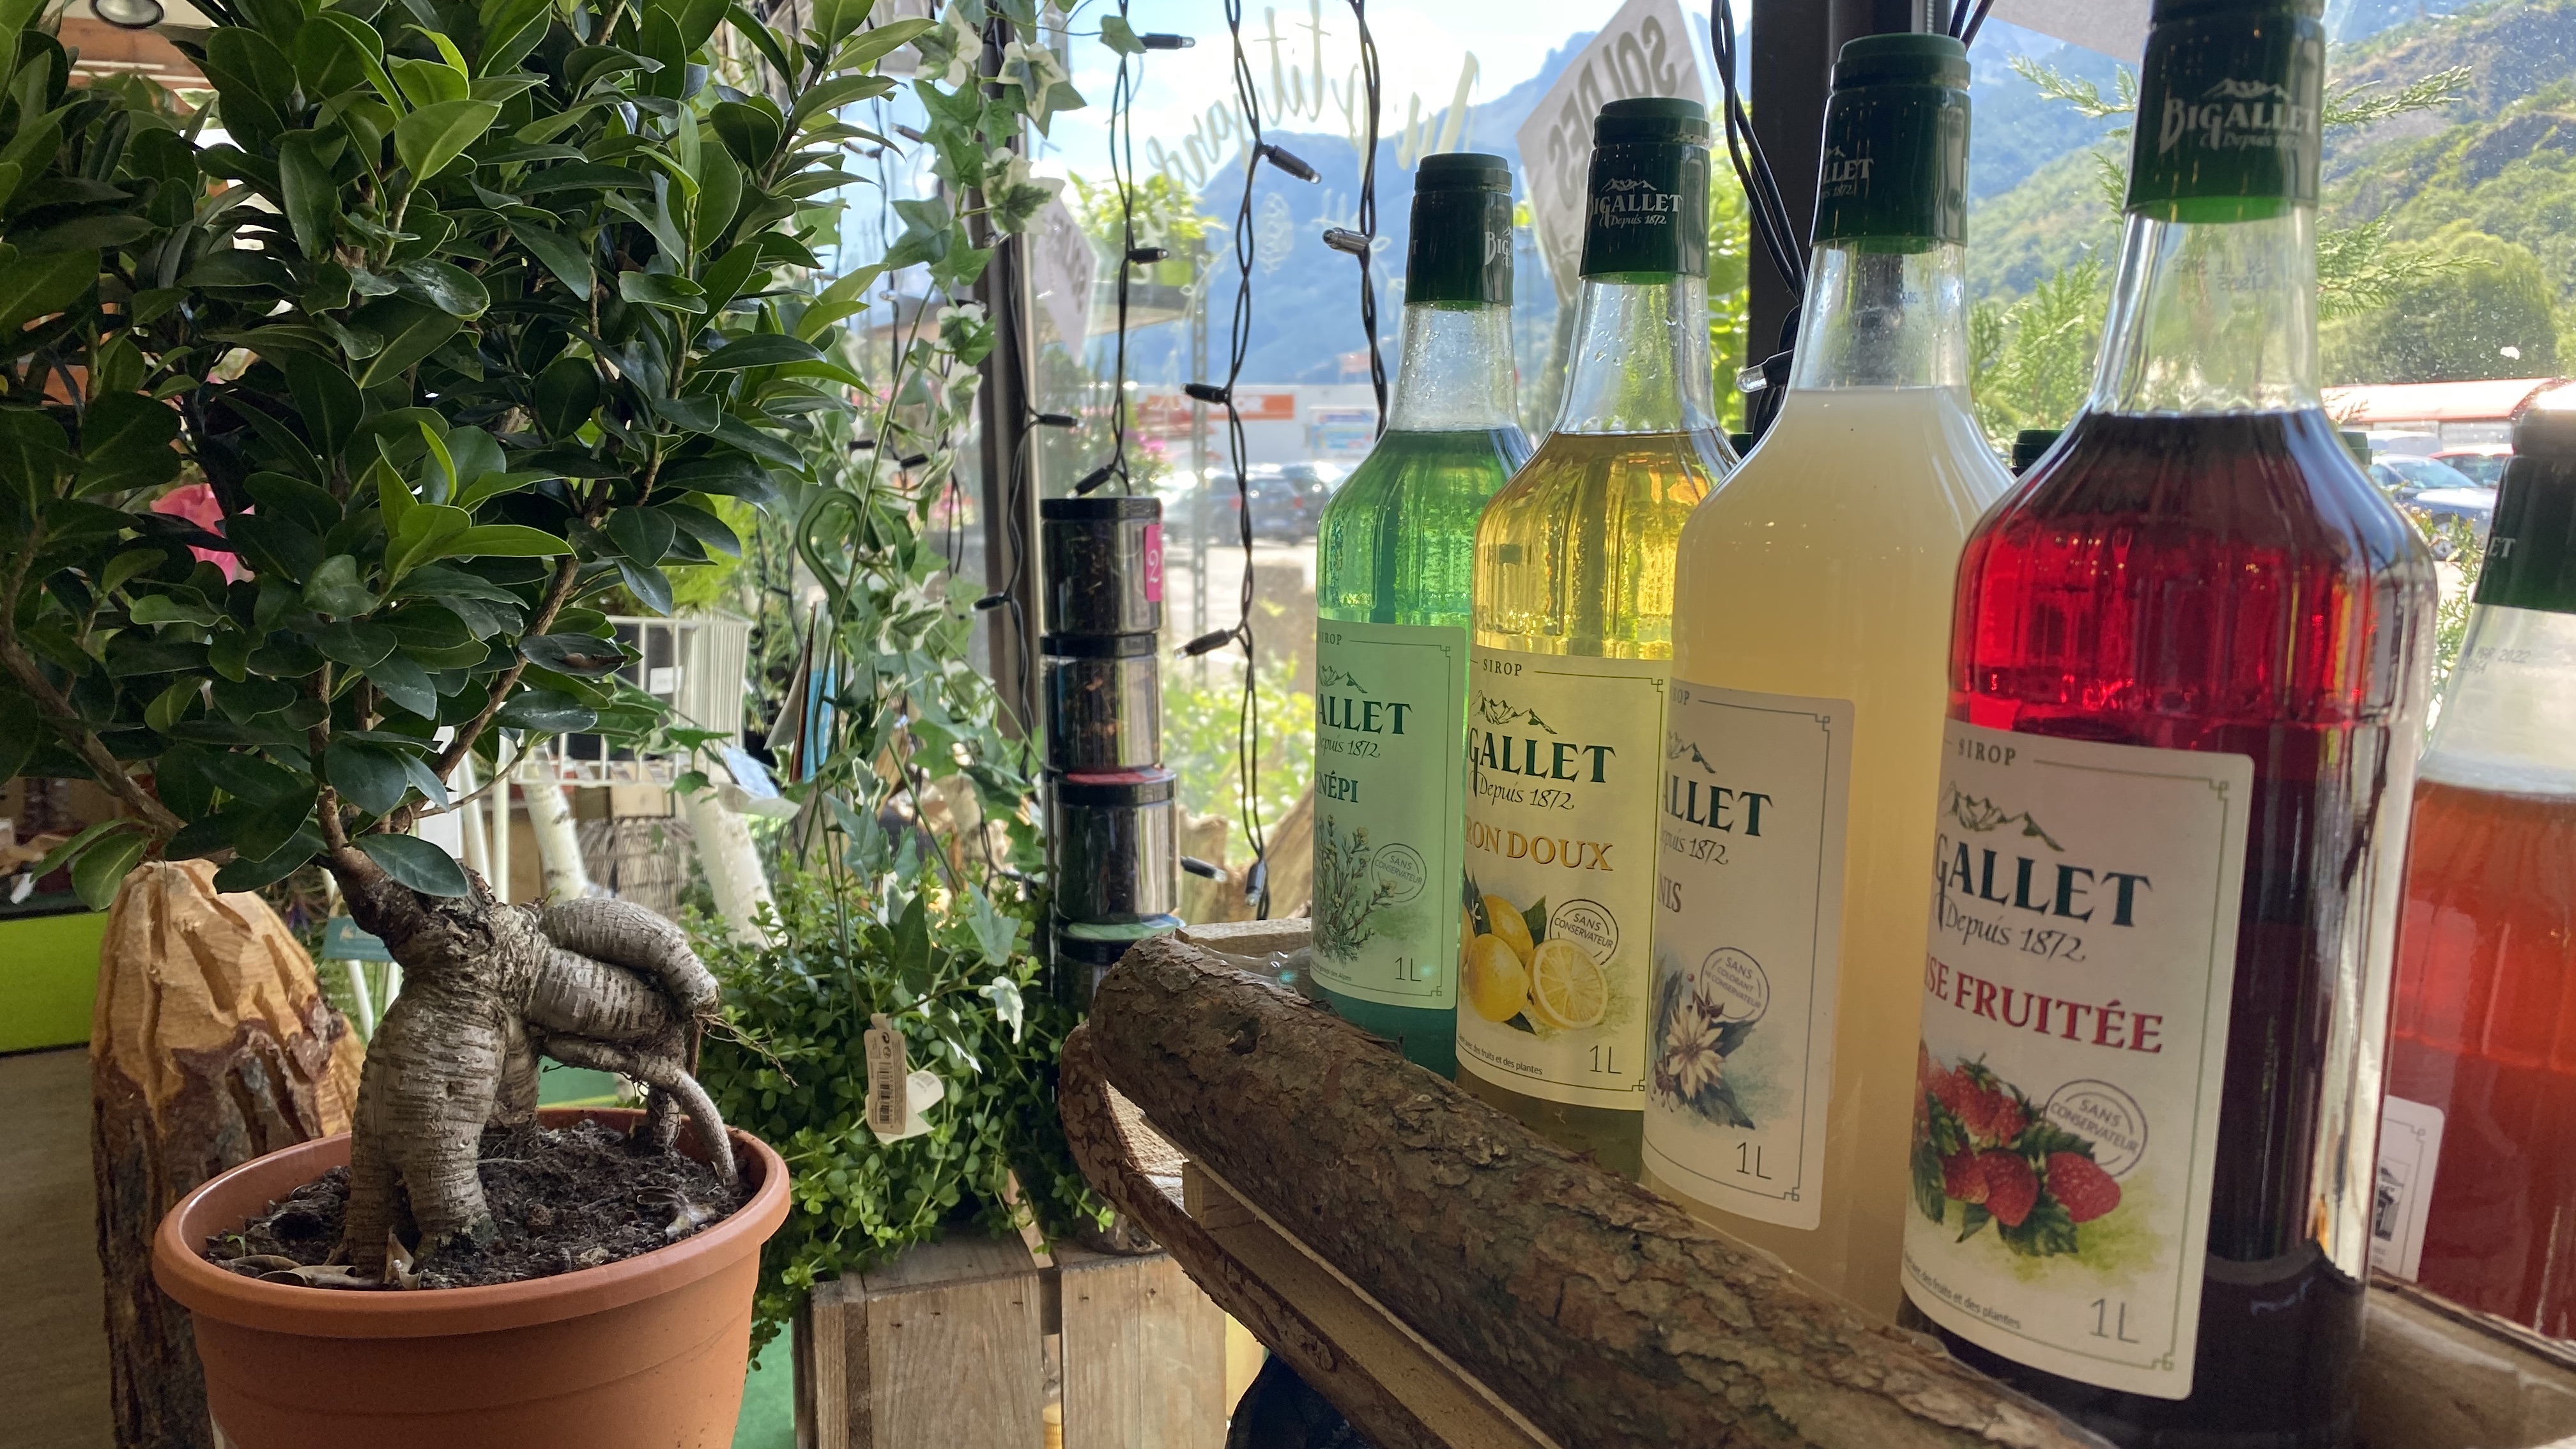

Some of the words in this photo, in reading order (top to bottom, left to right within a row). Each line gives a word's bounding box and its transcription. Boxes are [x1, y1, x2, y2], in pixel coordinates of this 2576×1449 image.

[2158, 98, 2317, 155] BIGALLET
[1824, 158, 1874, 183] LLET
[1611, 214, 1641, 229] Depuis
[1644, 214, 1667, 226] 1872
[1483, 659, 1522, 677] SIROP
[2497, 648, 2531, 664] 2022
[1317, 693, 1413, 735] ALLET
[1347, 739, 1381, 759] 1872
[1467, 726, 1616, 799] GALLET
[1958, 737, 2016, 766] SIROP
[1315, 769, 1359, 803] NÉPI
[1479, 776, 1524, 806] Depuis
[1529, 788, 1575, 811] 1872
[1465, 816, 1501, 855] RON
[1506, 830, 1614, 871] DOUX
[1662, 828, 1685, 854] puis
[1689, 837, 1729, 866] 1872
[1374, 859, 1423, 885] CONSERVATEUR
[1390, 855, 1413, 870] SANS
[1657, 870, 1682, 914] NIS
[1934, 833, 2153, 932] GALLET
[1554, 917, 1614, 949] CONSERVATEUR
[1573, 912, 1602, 931] SANS
[1945, 901, 2012, 946] Depuis
[2020, 926, 2087, 963] 1872
[1717, 966, 1754, 992] COLORANT
[1725, 956, 1753, 979] SANS
[1711, 974, 1761, 1009] CONSERVATEUR
[1954, 970, 2164, 1054] FRUITÉE
[1481, 1048, 1494, 1061] fruits
[1496, 1055, 1502, 1064] et
[1503, 1058, 1515, 1068] des
[1515, 1062, 1544, 1075] plantes
[2049, 1101, 2140, 1154] CONSERVATEUR
[2078, 1098, 2123, 1128] SANS
[1964, 1297, 1981, 1314] des
[1982, 1306, 2021, 1330] plantes
